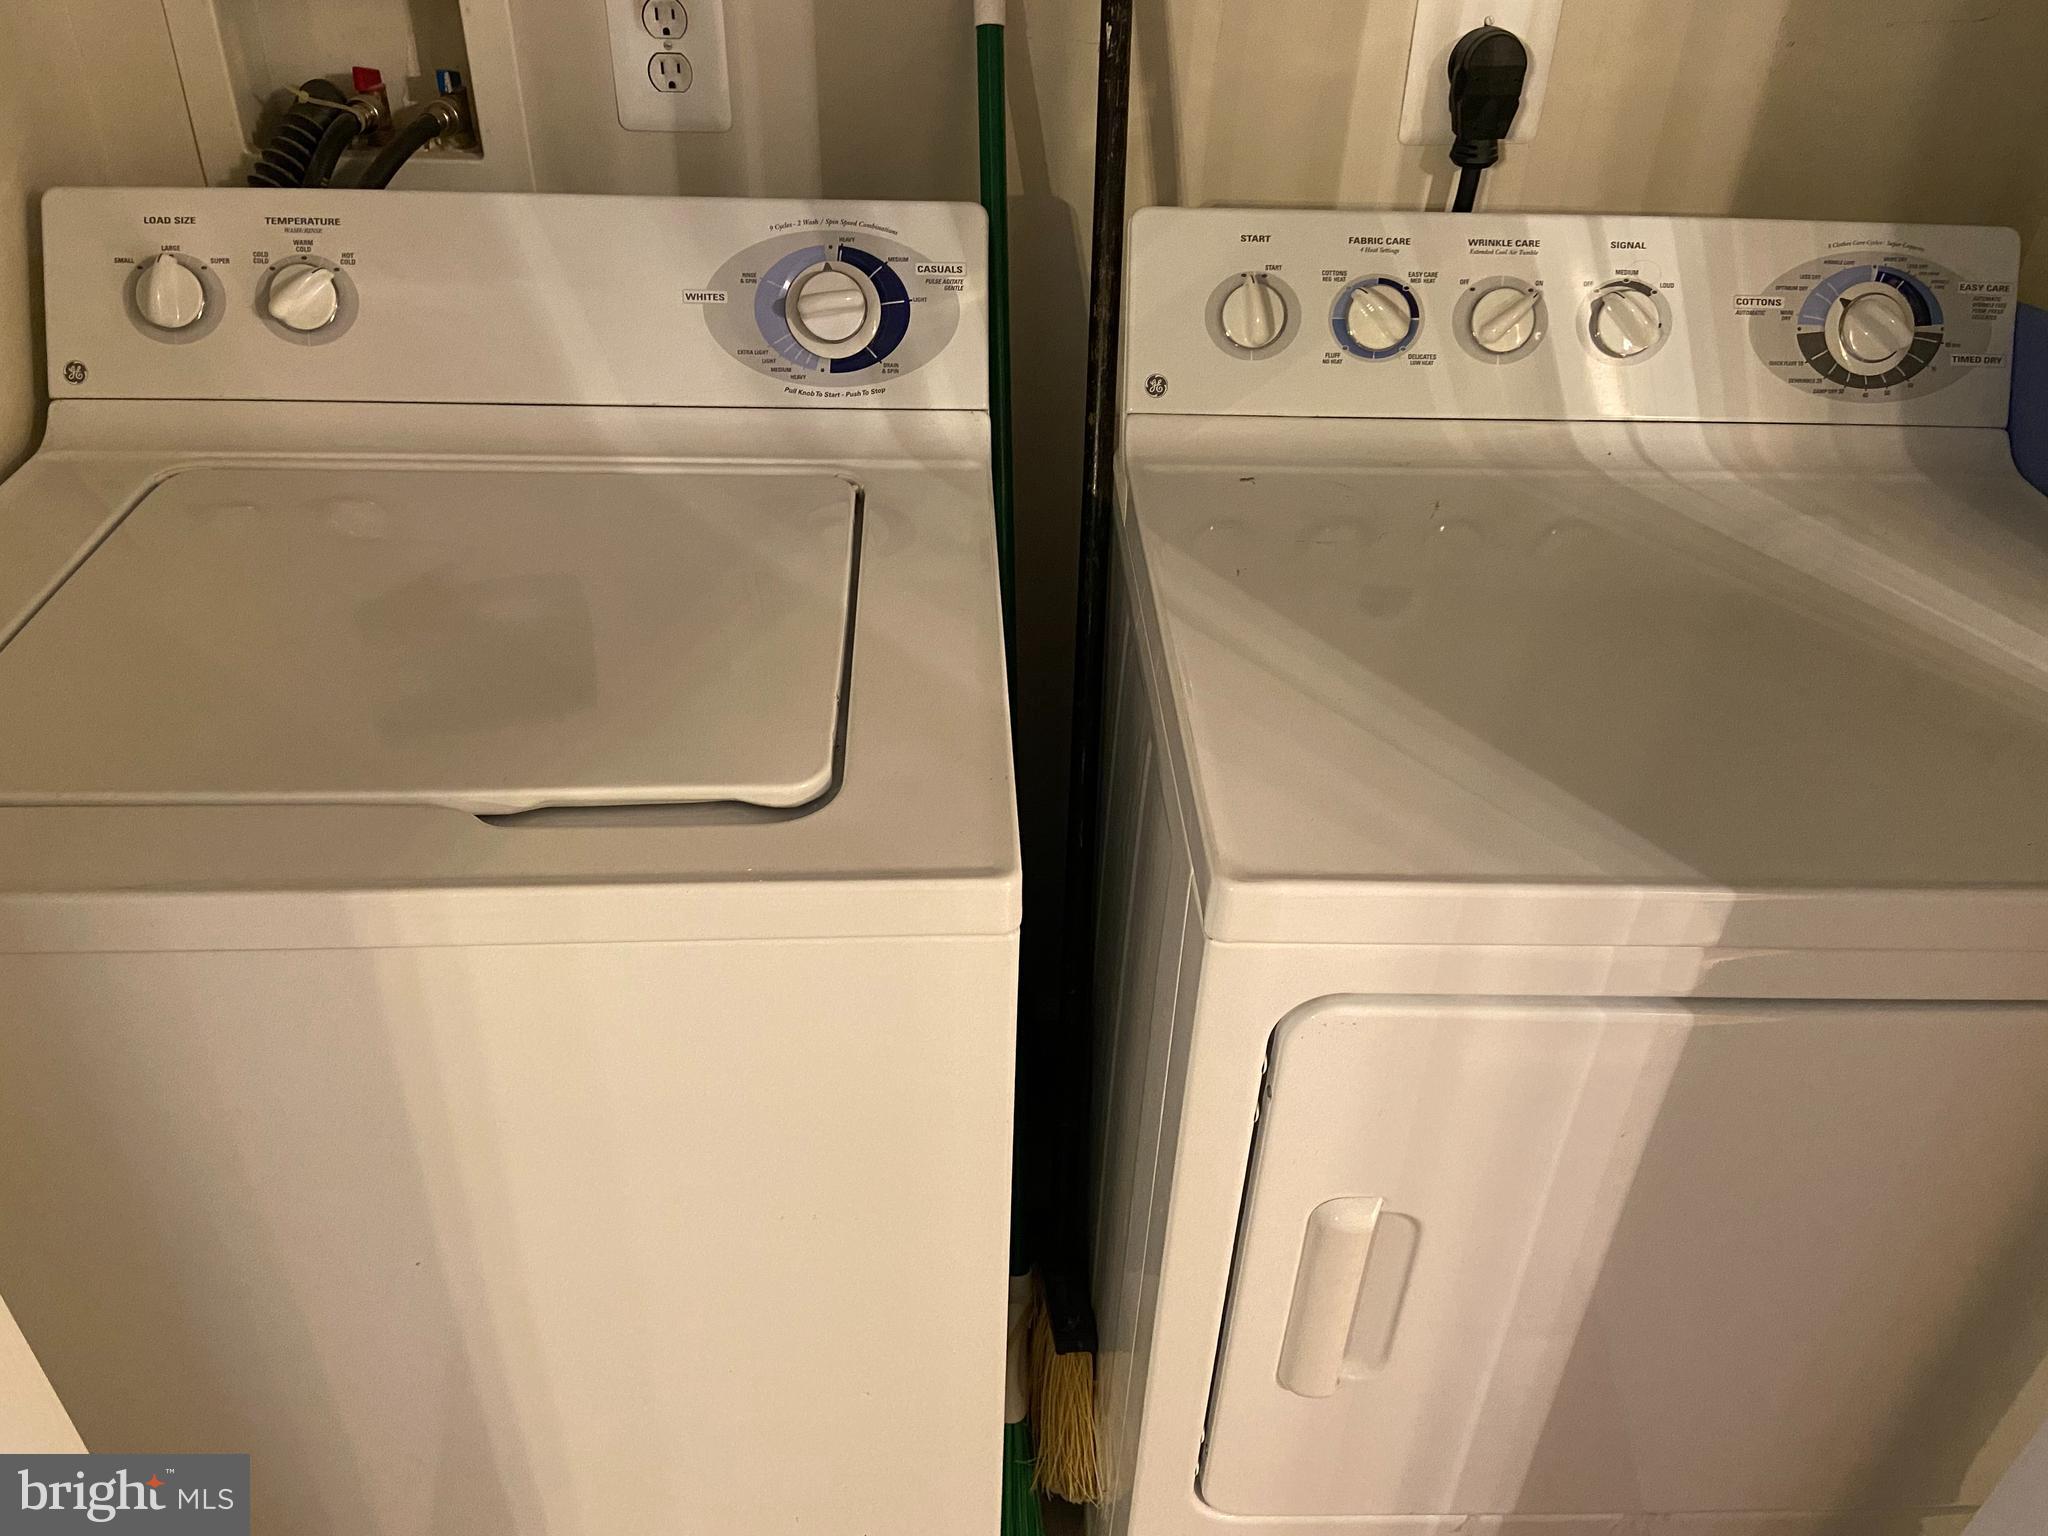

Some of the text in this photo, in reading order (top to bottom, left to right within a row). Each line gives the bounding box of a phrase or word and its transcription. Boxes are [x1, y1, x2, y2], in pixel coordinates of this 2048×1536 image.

[143, 216, 196, 224] LOAD SIZE
[265, 217, 341, 226] TEMPERATURE
[775, 223, 792, 231] Cycles
[826, 218, 839, 226] Spin
[841, 219, 857, 227] Speed
[858, 220, 898, 235] Combinations
[1240, 235, 1271, 243] START
[1348, 236, 1411, 245] FABRIC CARE
[1468, 239, 1540, 247] WRINKLE CARE
[1610, 241, 1646, 249] SIGNAL
[917, 265, 963, 274] CASUALS
[686, 293, 725, 301] WHITES
[1736, 298, 1782, 306] COTTONS
[1984, 356, 2001, 364] DRY
[785, 386, 797, 394] Pull
[798, 389, 815, 397] Knob
[846, 390, 862, 398] Push
[871, 387, 886, 396] Stop
